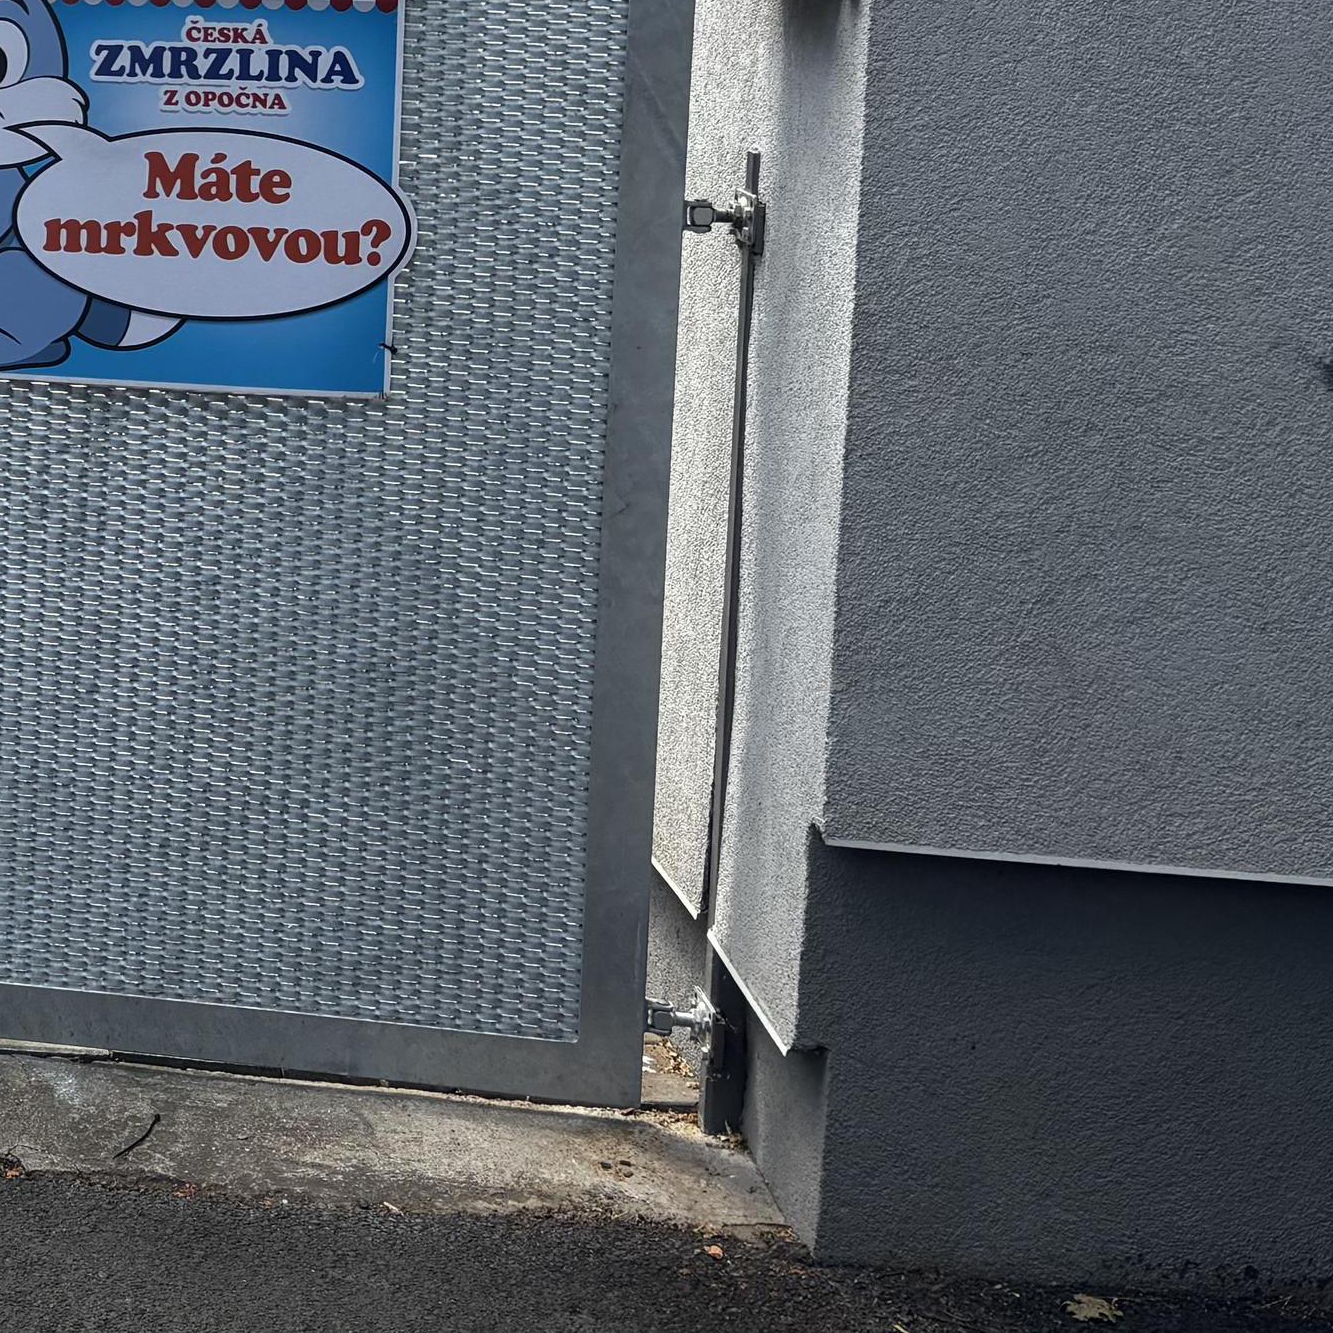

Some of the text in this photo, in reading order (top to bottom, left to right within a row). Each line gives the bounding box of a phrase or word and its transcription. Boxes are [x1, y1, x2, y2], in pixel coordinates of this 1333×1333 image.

[185, 20, 269, 45] ČESKÁ
[94, 44, 360, 84] ZMRZLINA
[163, 86, 287, 110] Z OPOČNA
[142, 152, 293, 204] Máte
[42, 210, 392, 266] mrkvovou?
